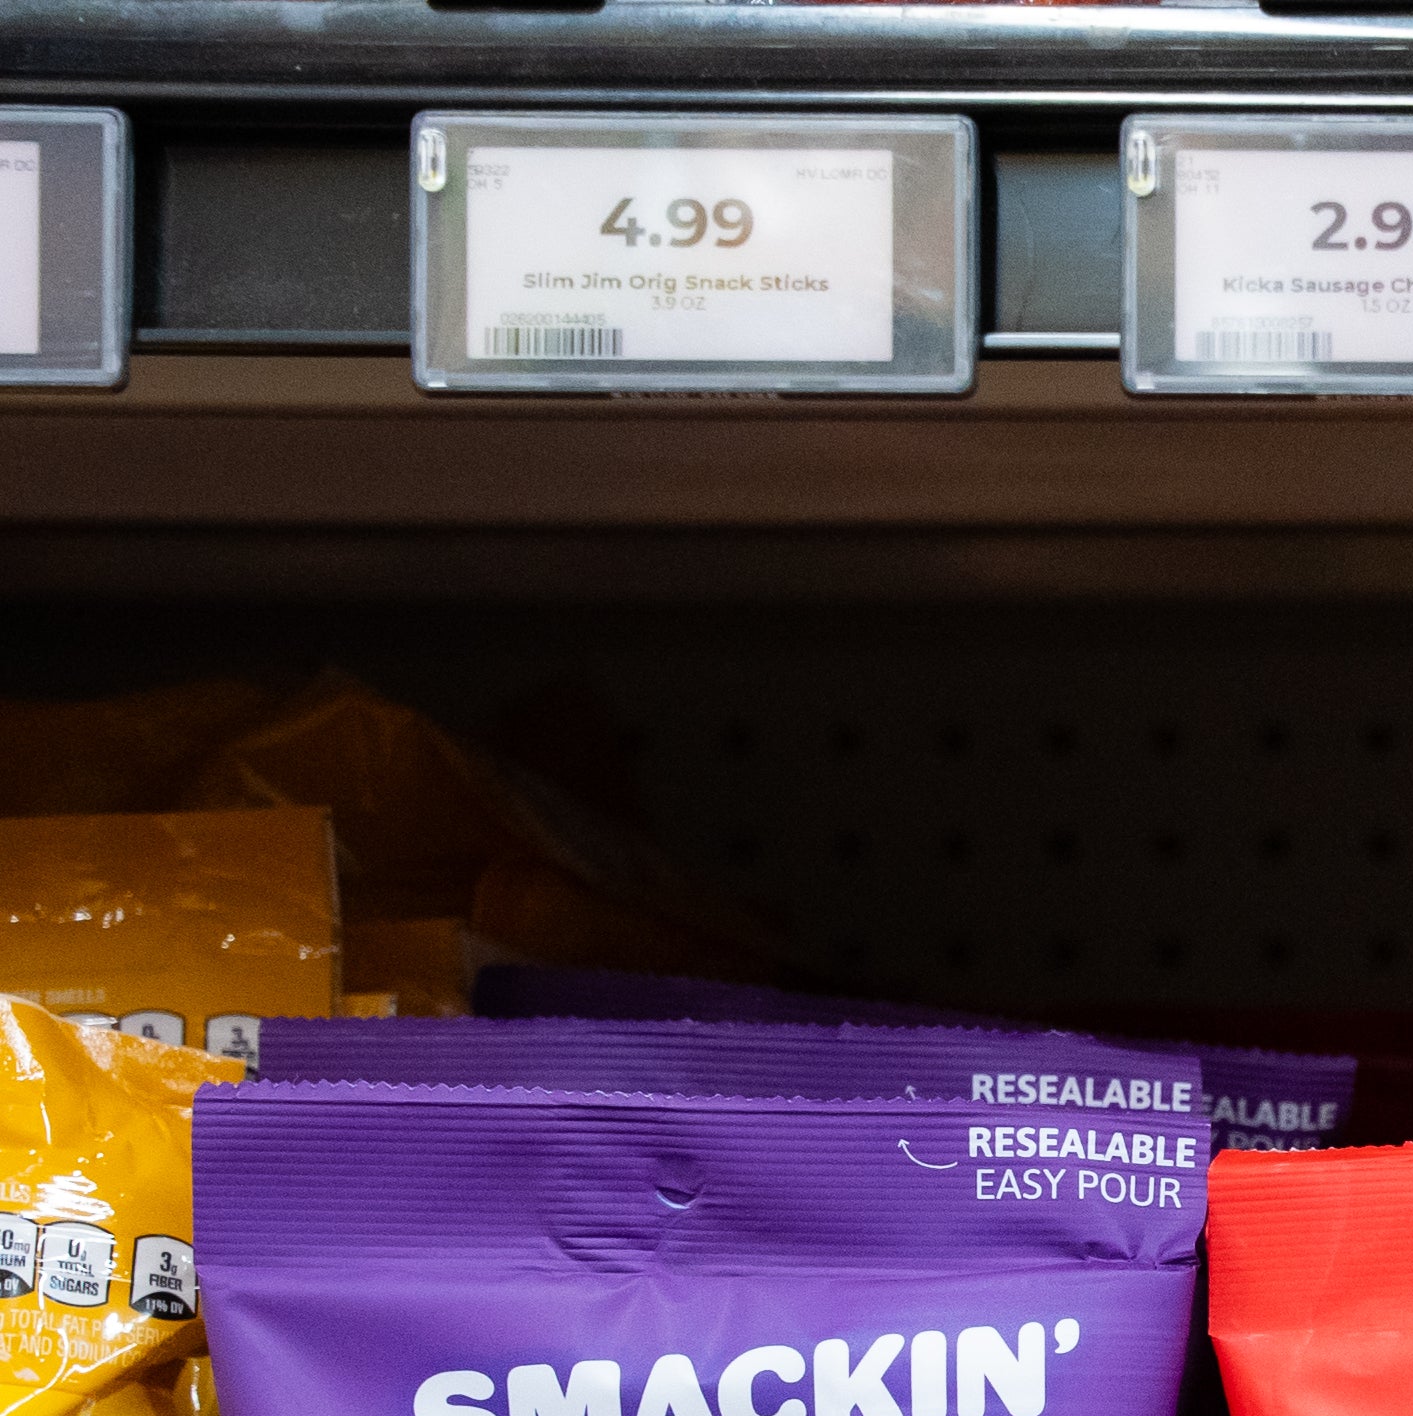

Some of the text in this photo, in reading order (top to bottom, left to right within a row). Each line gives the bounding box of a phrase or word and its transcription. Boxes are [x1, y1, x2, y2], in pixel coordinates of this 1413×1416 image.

[600, 198, 754, 248] 4.99
[523, 272, 829, 294] Slim Jim Orig Snack Sticks
[1222, 276, 1284, 294] Kicka
[1291, 277, 1385, 297] Sausage
[681, 296, 706, 311] OZ
[1386, 299, 1411, 314] OZ
[971, 1073, 1193, 1113] RESEALABLE
[967, 1126, 1197, 1169] RESEALABLE
[975, 1168, 1183, 1209] EASY POUR
[159, 1250, 178, 1276] 3g
[49, 1274, 100, 1297] SUGARS
[148, 1272, 183, 1293] FIBER
[144, 1298, 184, 1316] 11% DV
[9, 1308, 57, 1330] TOTAL
[62, 1313, 91, 1334] FAT
[17, 1331, 52, 1356] AND
[56, 1339, 121, 1367] SODIUM
